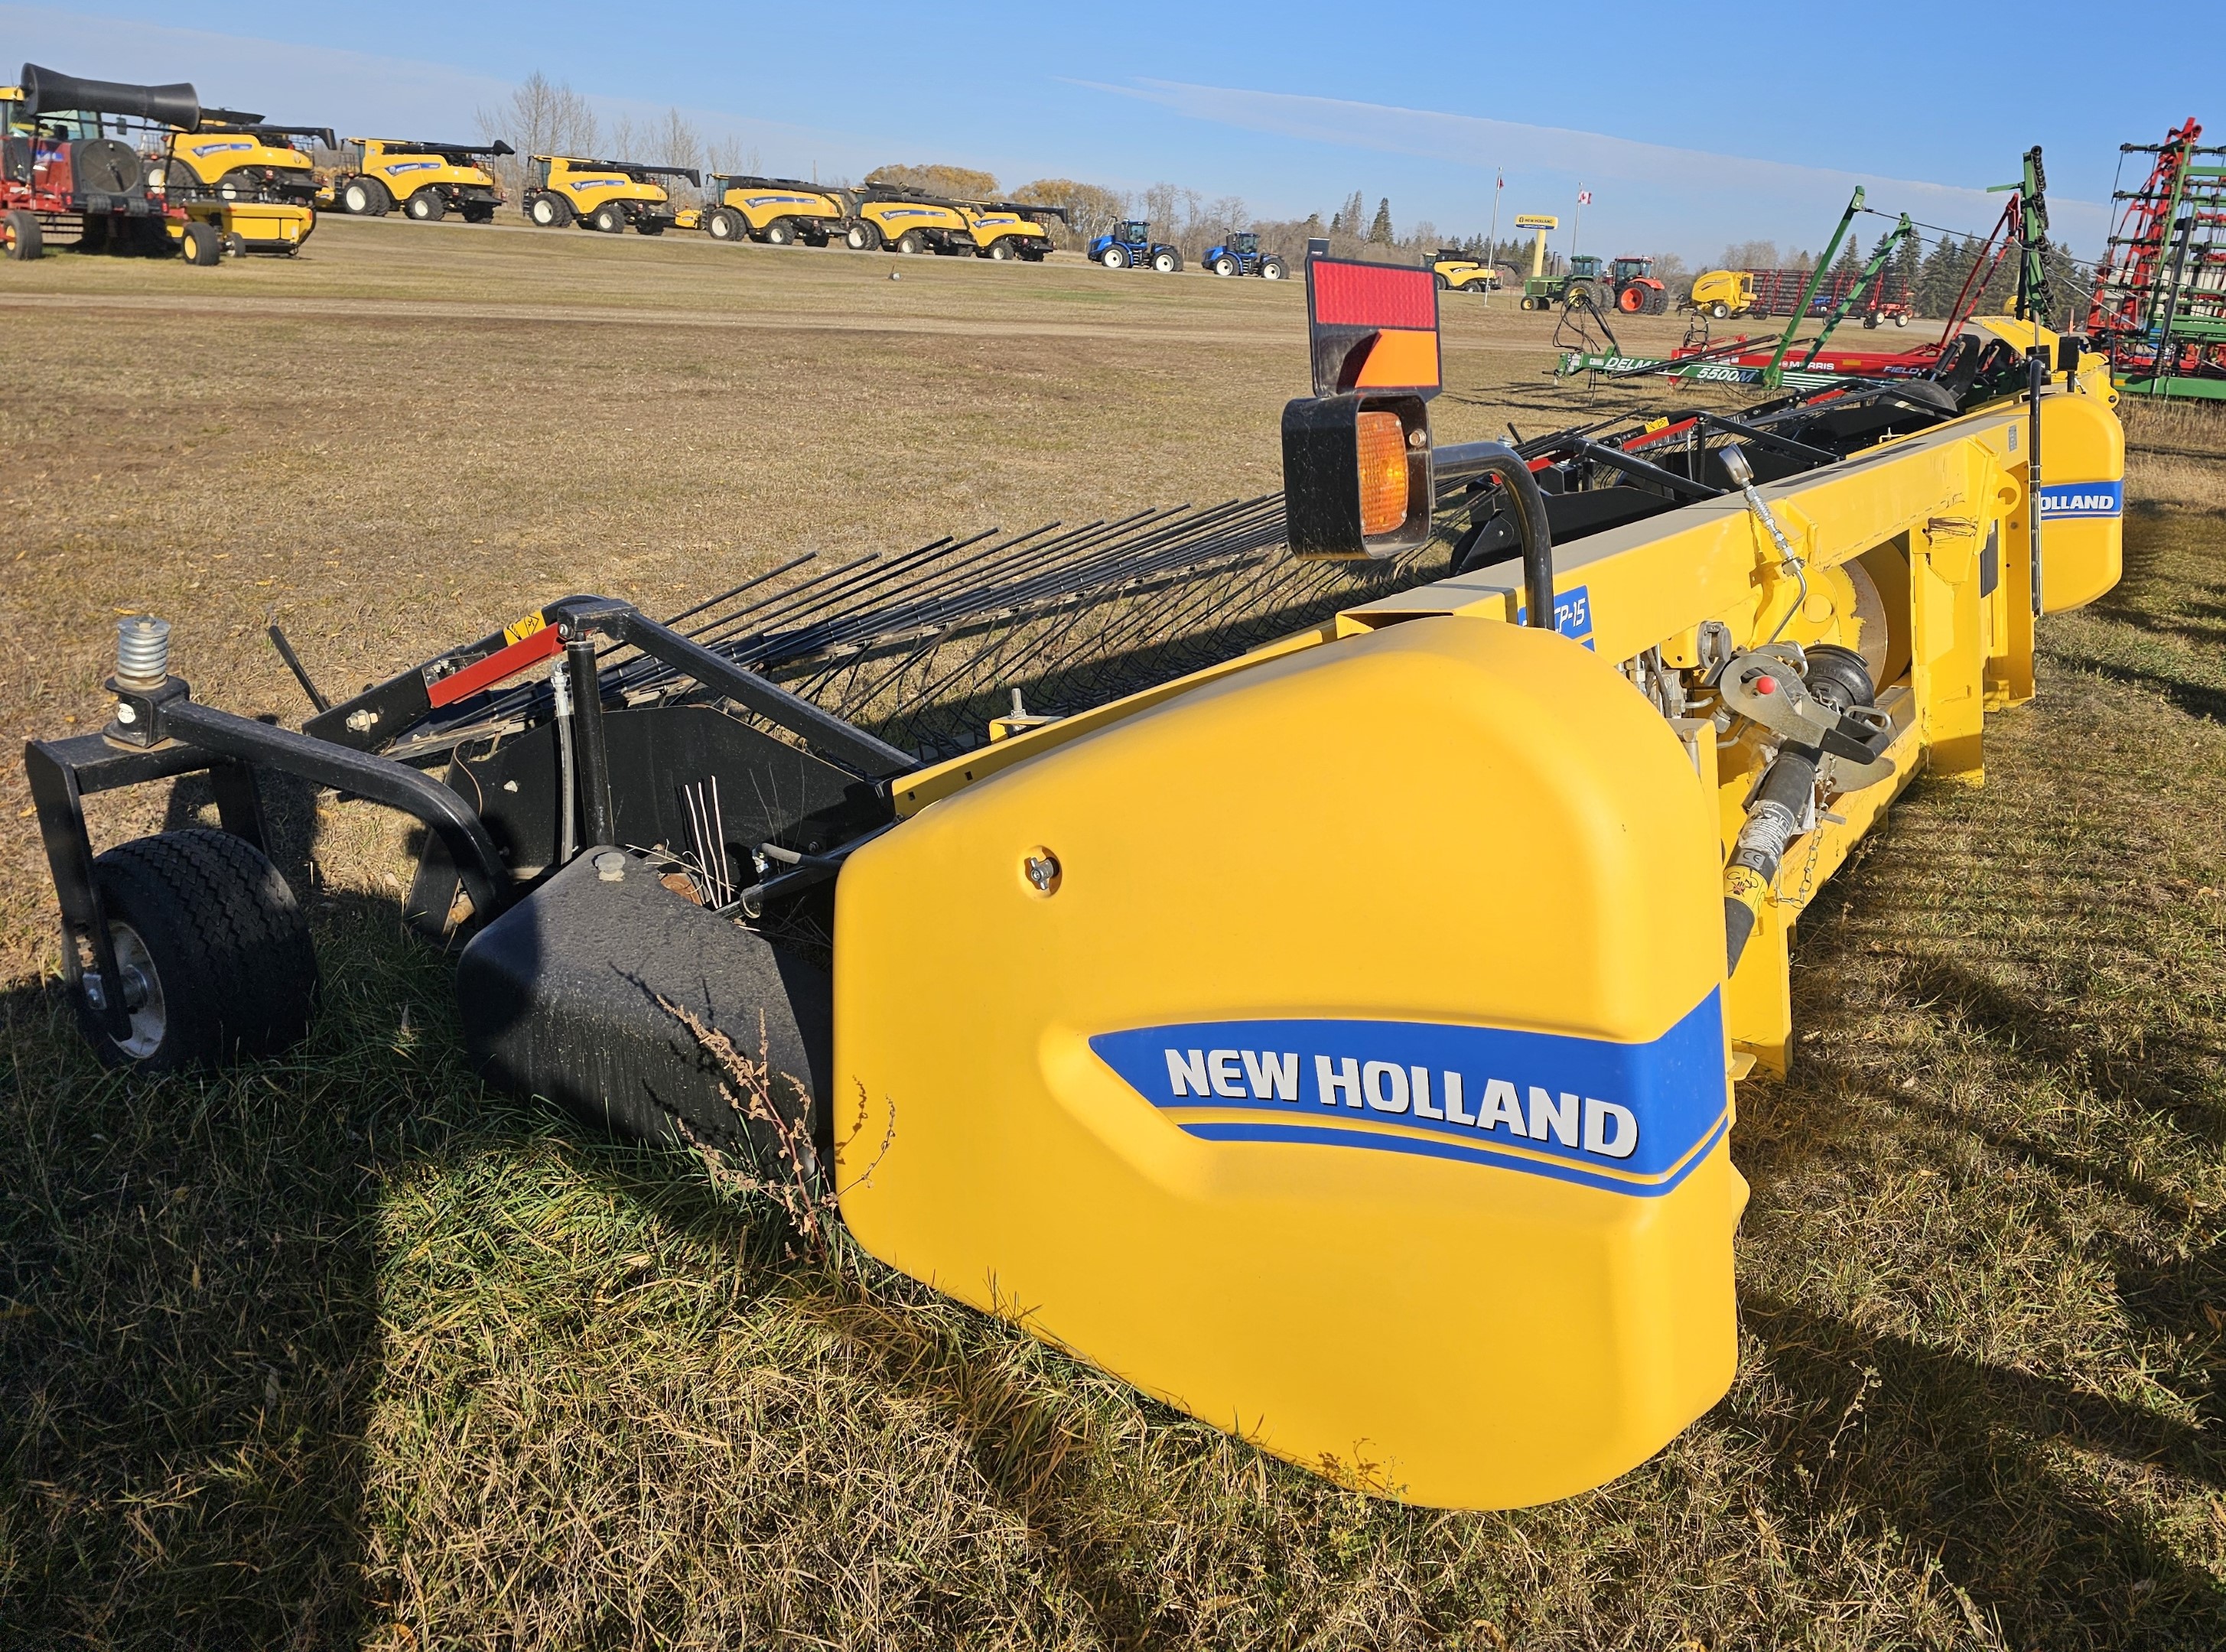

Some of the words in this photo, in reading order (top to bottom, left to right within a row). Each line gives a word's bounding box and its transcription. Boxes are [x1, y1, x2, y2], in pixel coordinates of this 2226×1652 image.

[1606, 356, 1661, 370] DELM
[1789, 361, 1835, 370] MRRIS
[2040, 495, 2114, 511] OLLAND
[1554, 597, 1586, 633] P-15
[1164, 1048, 1299, 1103] NEW
[1314, 1055, 1639, 1160] HOLLAND
